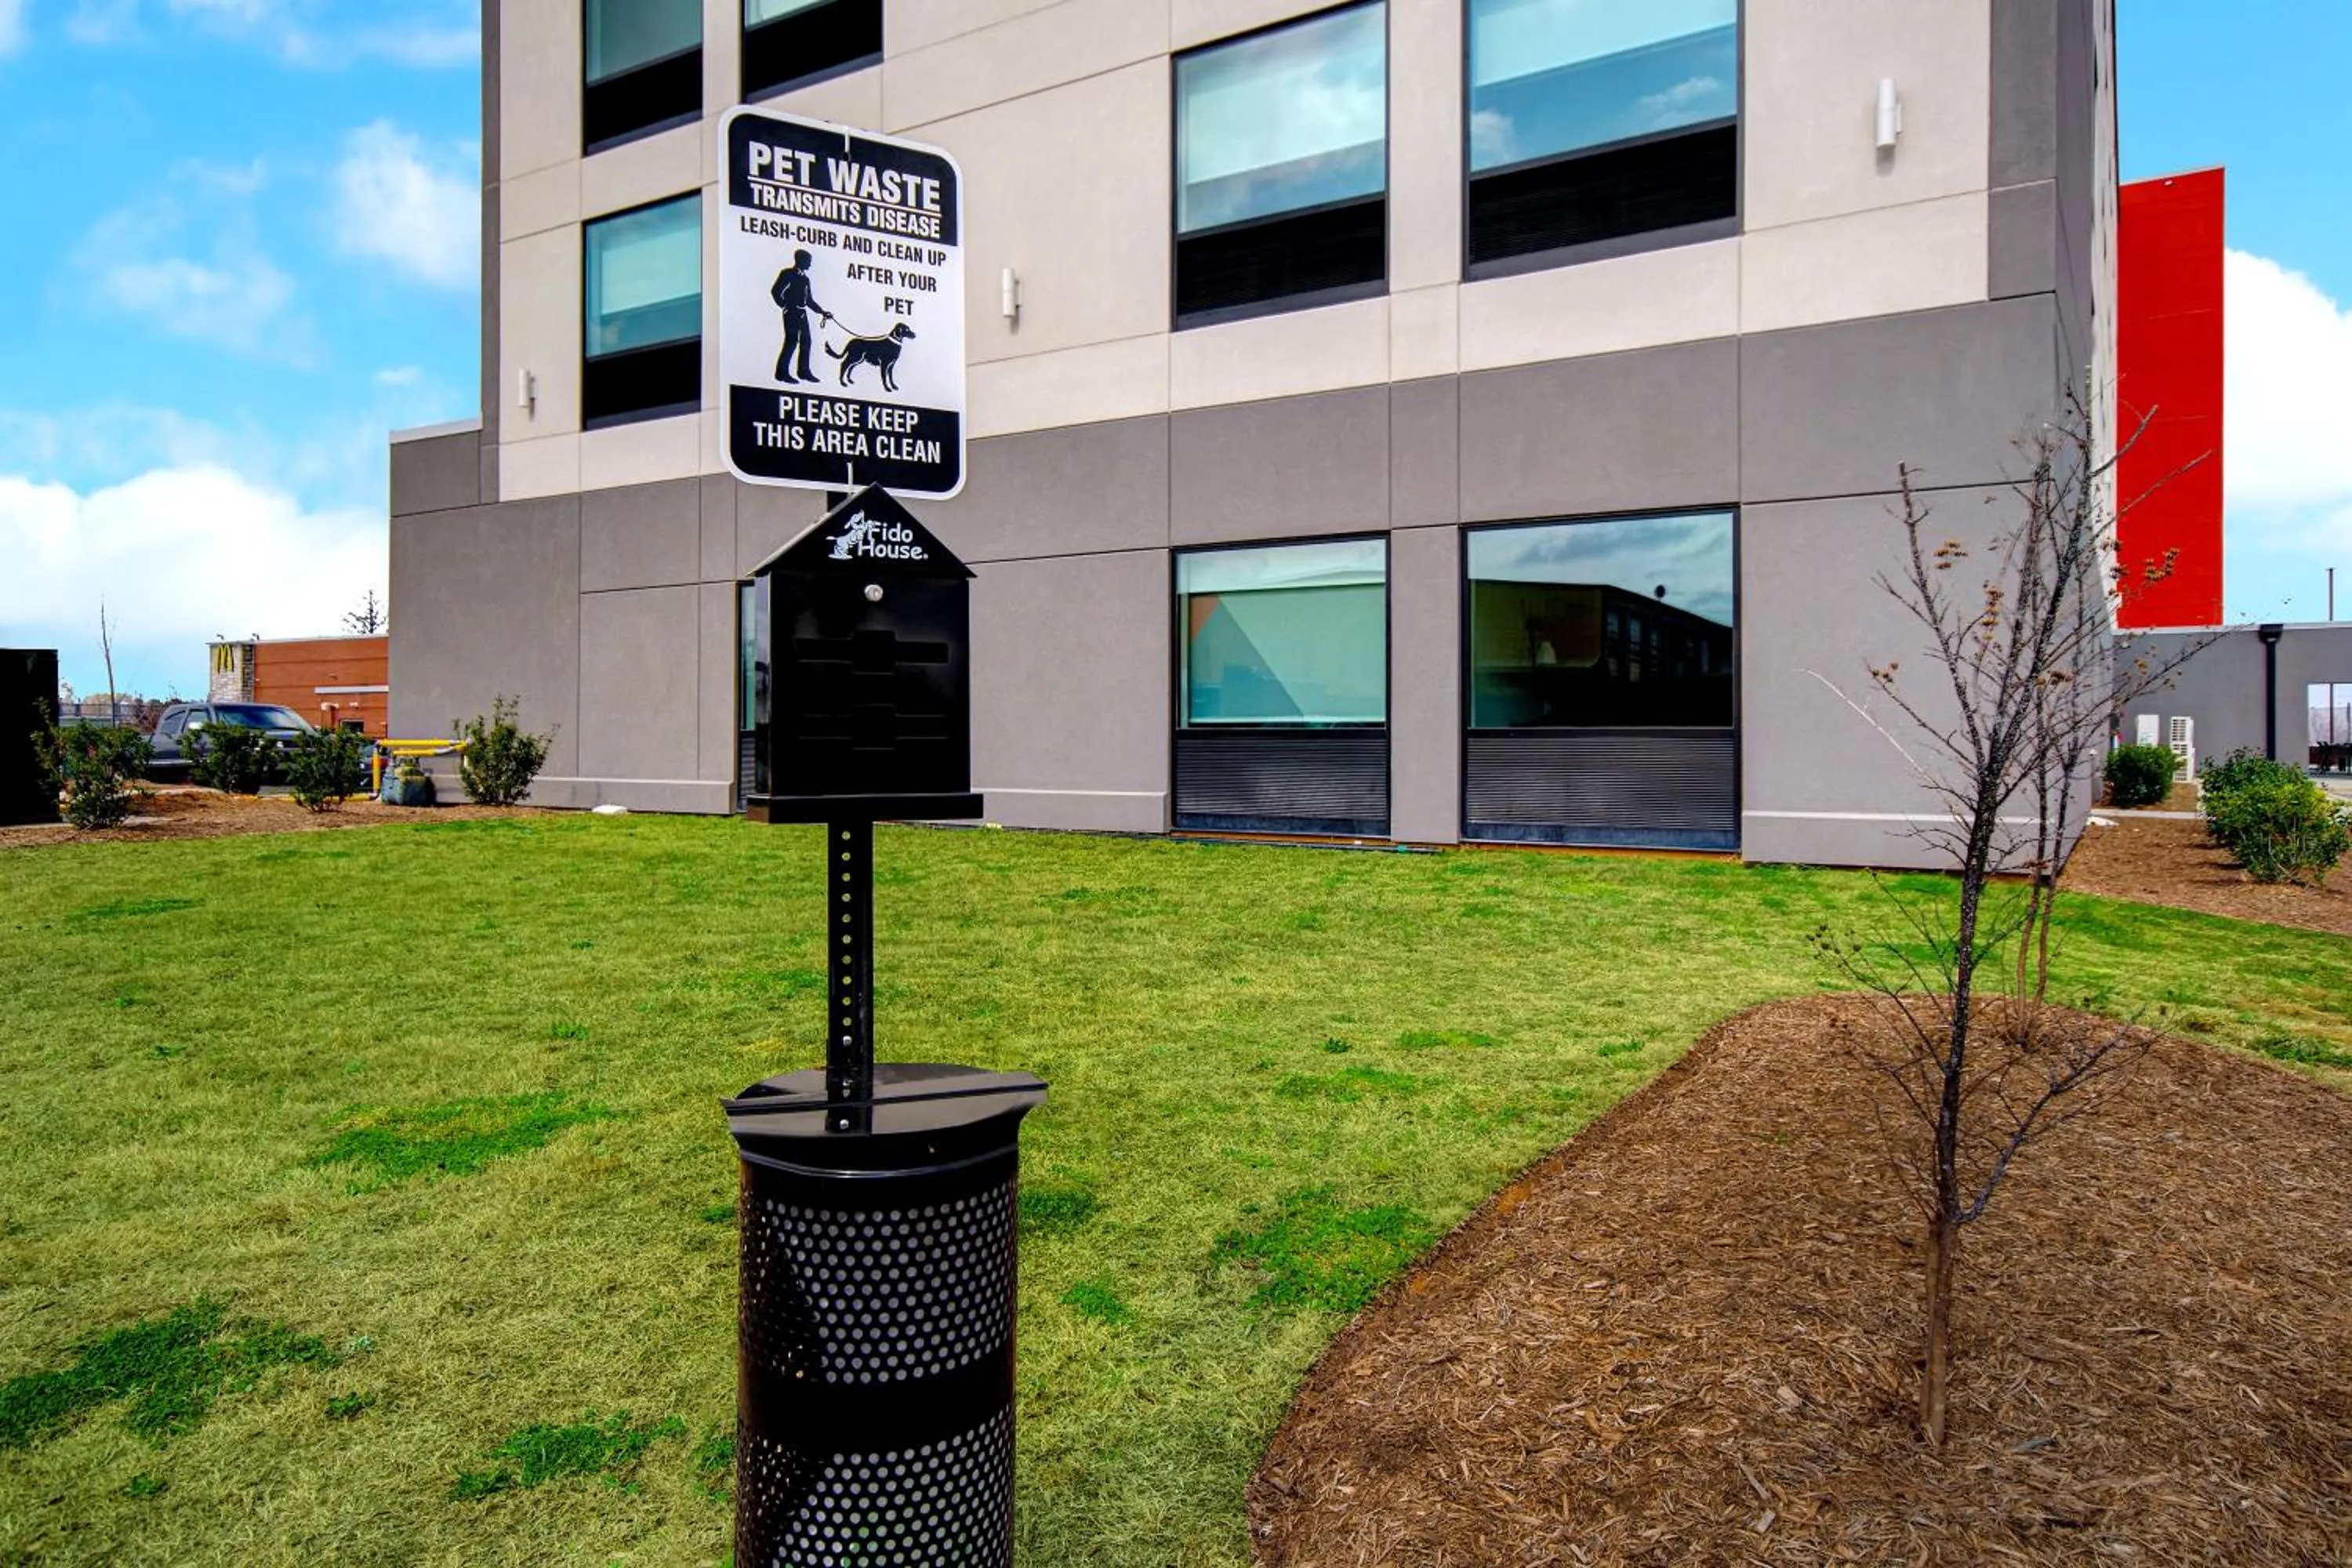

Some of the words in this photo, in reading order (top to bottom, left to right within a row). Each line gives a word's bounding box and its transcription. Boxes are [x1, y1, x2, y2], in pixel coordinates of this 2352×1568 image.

[749, 141, 815, 186] PET
[828, 158, 940, 212] WASTE
[750, 183, 860, 223] TRANSMITS
[866, 205, 940, 238] DISEASE
[741, 216, 837, 247] LEASH-CURB
[843, 235, 872, 254] AND
[877, 241, 923, 263] CLEAN
[927, 249, 946, 266] UP
[847, 263, 893, 285] AFTER
[898, 272, 937, 292] YOUR
[884, 296, 914, 315] PET
[779, 396, 860, 427] PLEASE
[868, 407, 918, 433] KEEP
[753, 422, 804, 449] THIS
[812, 430, 869, 457] AREA
[876, 435, 940, 463] CLEAN
[867, 521, 913, 542] Fido
